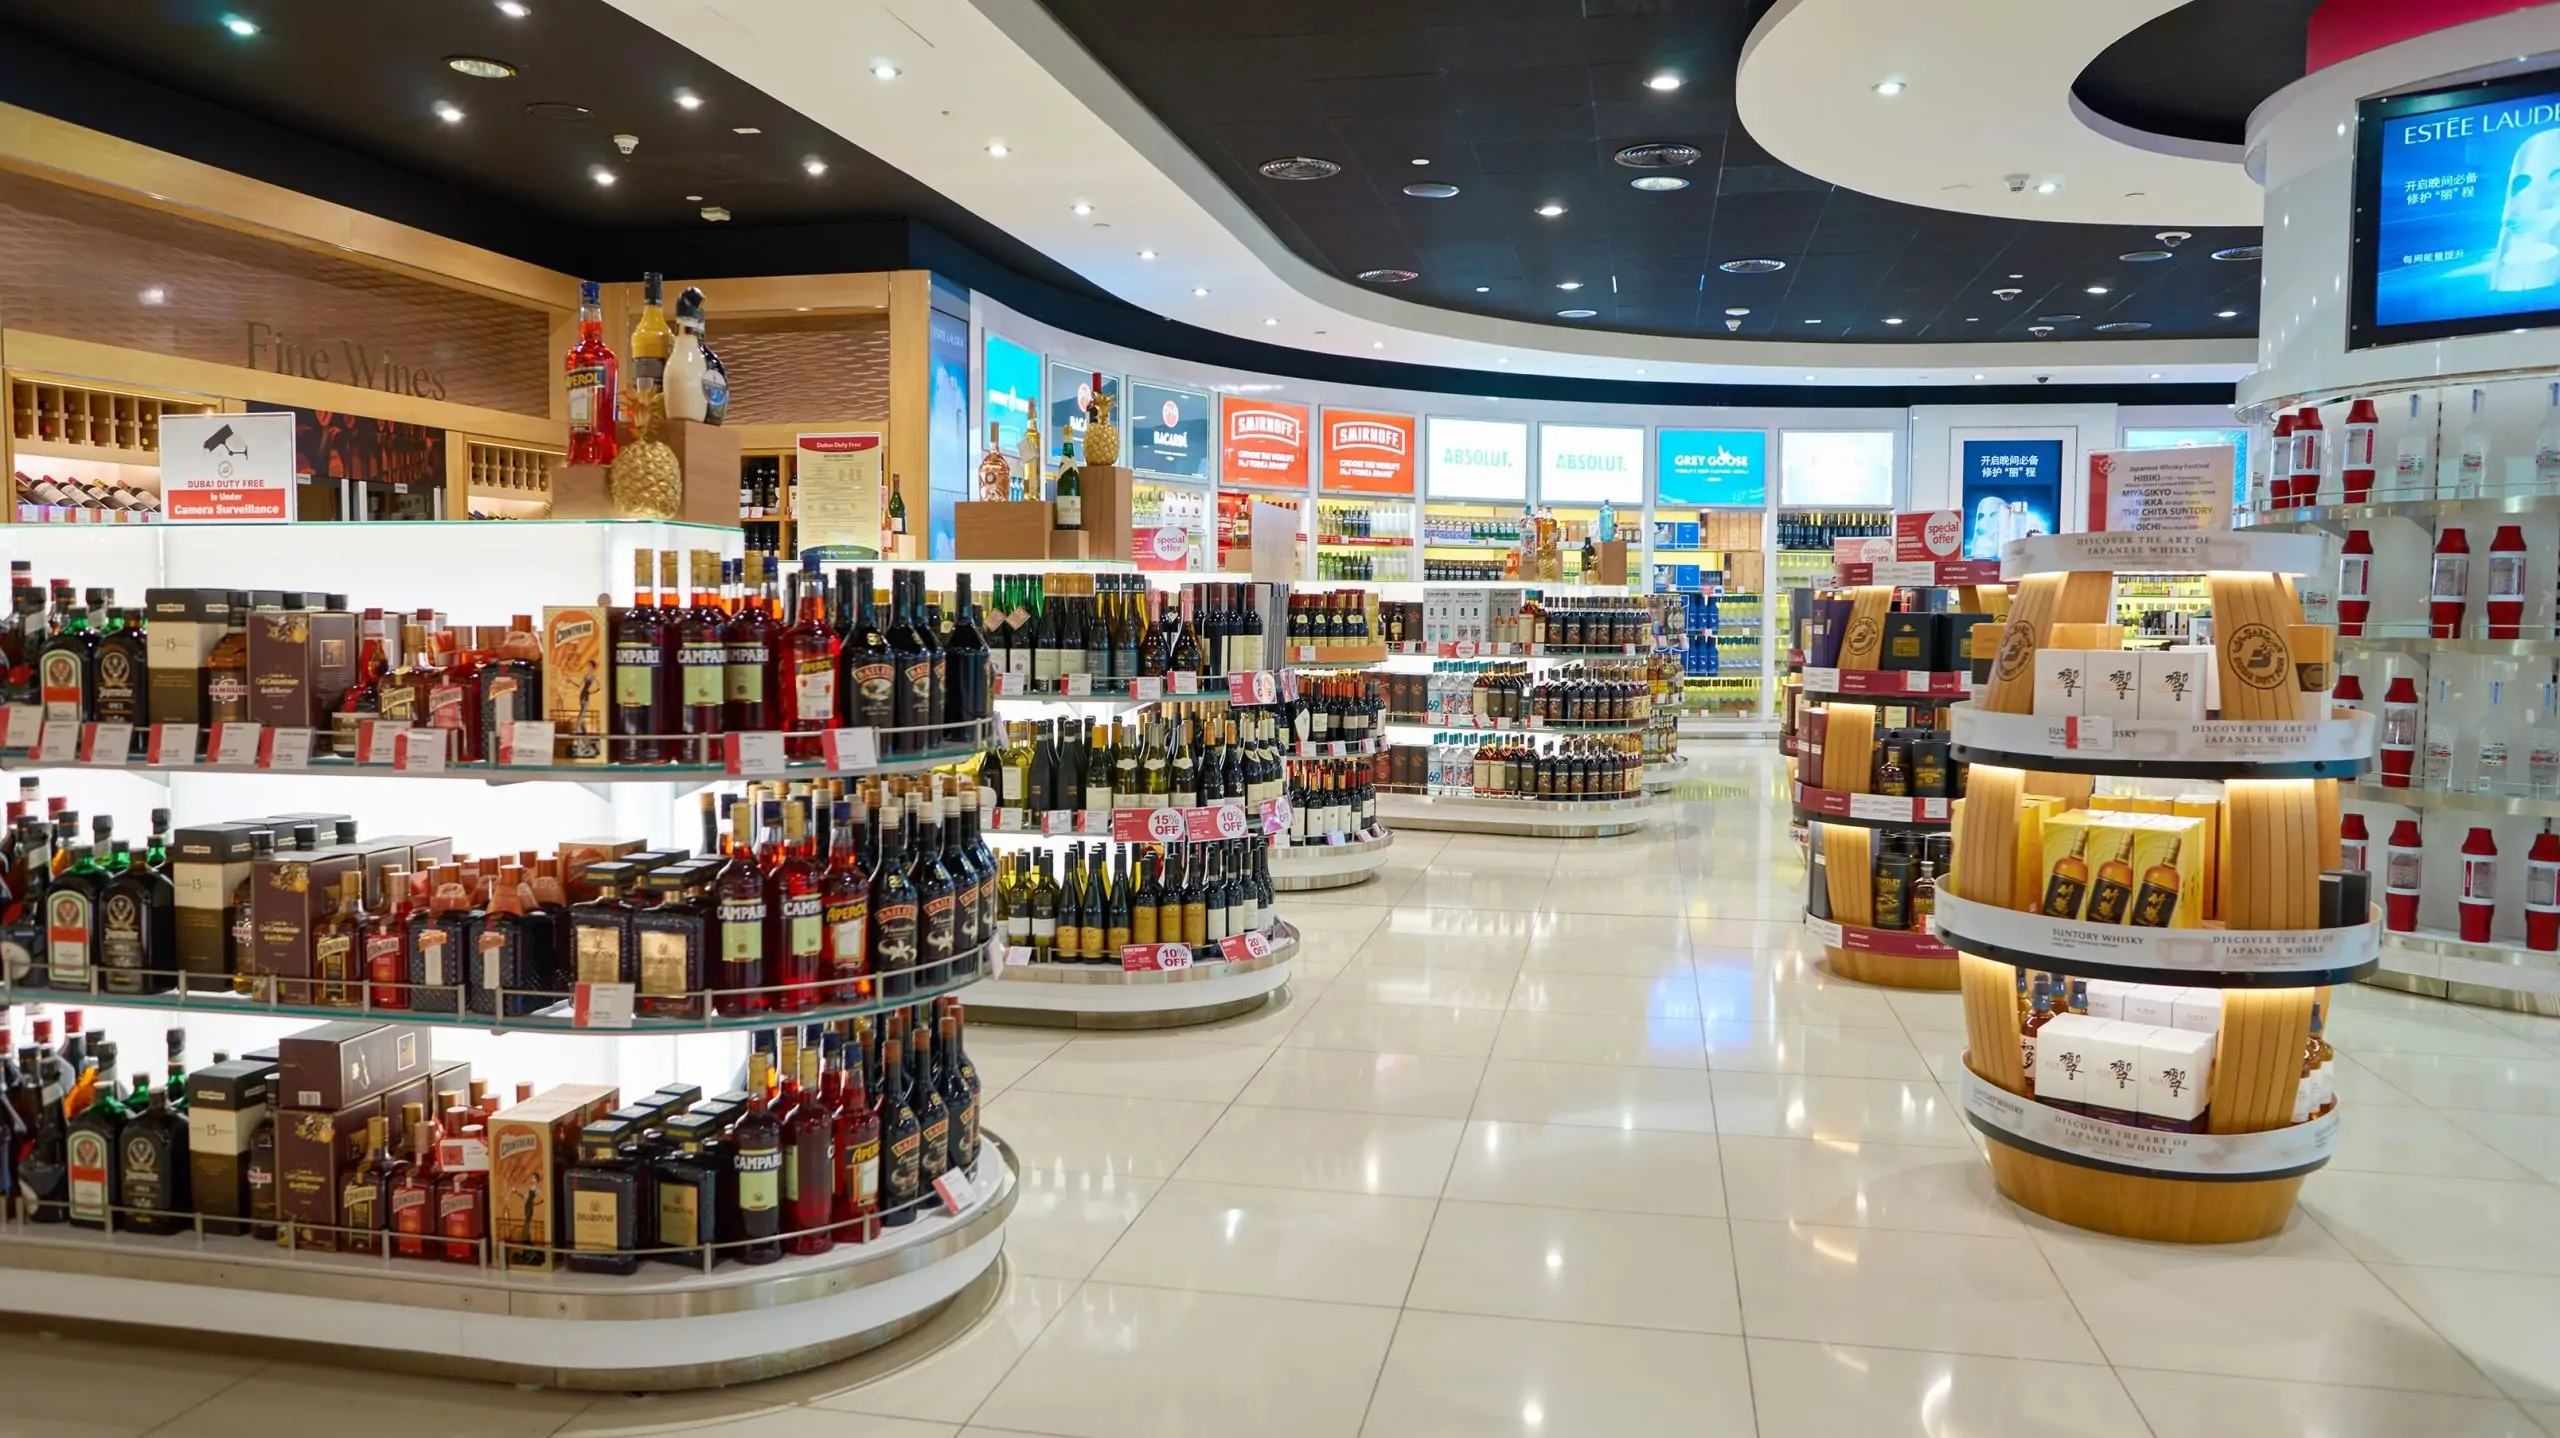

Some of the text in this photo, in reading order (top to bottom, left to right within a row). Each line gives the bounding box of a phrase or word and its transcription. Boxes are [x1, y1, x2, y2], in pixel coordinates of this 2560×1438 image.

[2405, 172, 2479, 193] 开启晚间必备
[244, 319, 447, 401] Fine Wines
[1237, 415, 1294, 440] SMIRNOFF
[1339, 426, 1400, 448] SMIRNOFF
[1674, 453, 1749, 467] GREY GOOSE
[1980, 454, 2039, 467] 开启晚间必备
[2159, 463, 2183, 471] Whisky
[2184, 462, 2211, 470] Festival
[187, 480, 265, 488] DUBAI DUTY FREE
[2133, 474, 2161, 483] HIBIKI
[210, 492, 243, 501] Is Under
[2121, 488, 2172, 498] MIYAGIKYO
[2135, 498, 2164, 507] NIKKA
[174, 504, 279, 515] Camera Surveillance
[2122, 506, 2214, 517] THE CHITA SUNTORY
[1927, 521, 1960, 536] special
[2130, 523, 2161, 532] YOICHI
[1156, 535, 1186, 545] special
[1932, 533, 1956, 545] offer
[2077, 535, 2211, 546] DISCOVER THE ART OF
[1161, 543, 1182, 553] offer
[2087, 546, 2197, 556] JAPANESE WHISKY
[167, 637, 177, 651] 15
[1427, 699, 1441, 711] 69
[2113, 730, 2138, 738] ISKY
[1428, 771, 1441, 783] 69
[1153, 814, 1180, 826] 15%
[1221, 810, 1243, 822] 10%
[1155, 825, 1179, 835] OFF
[1222, 821, 1243, 832] OFF
[2051, 927, 2145, 945] SUNTORY WHISKY
[2212, 936, 2273, 944] DISCOVER
[2277, 936, 2297, 944] THE
[2301, 935, 2320, 944] ART
[1162, 948, 1188, 958] 10%
[1253, 945, 1270, 956] OFF
[2225, 945, 2324, 956] JAPANESE WHISKY
[1164, 957, 1188, 967] OFF
[206, 1123, 218, 1137] 15
[2054, 1114, 2189, 1148] DISCOVER THE ART OF
[2063, 1127, 2122, 1149] JAPANESE
[2125, 1141, 2174, 1156] WHISKY
